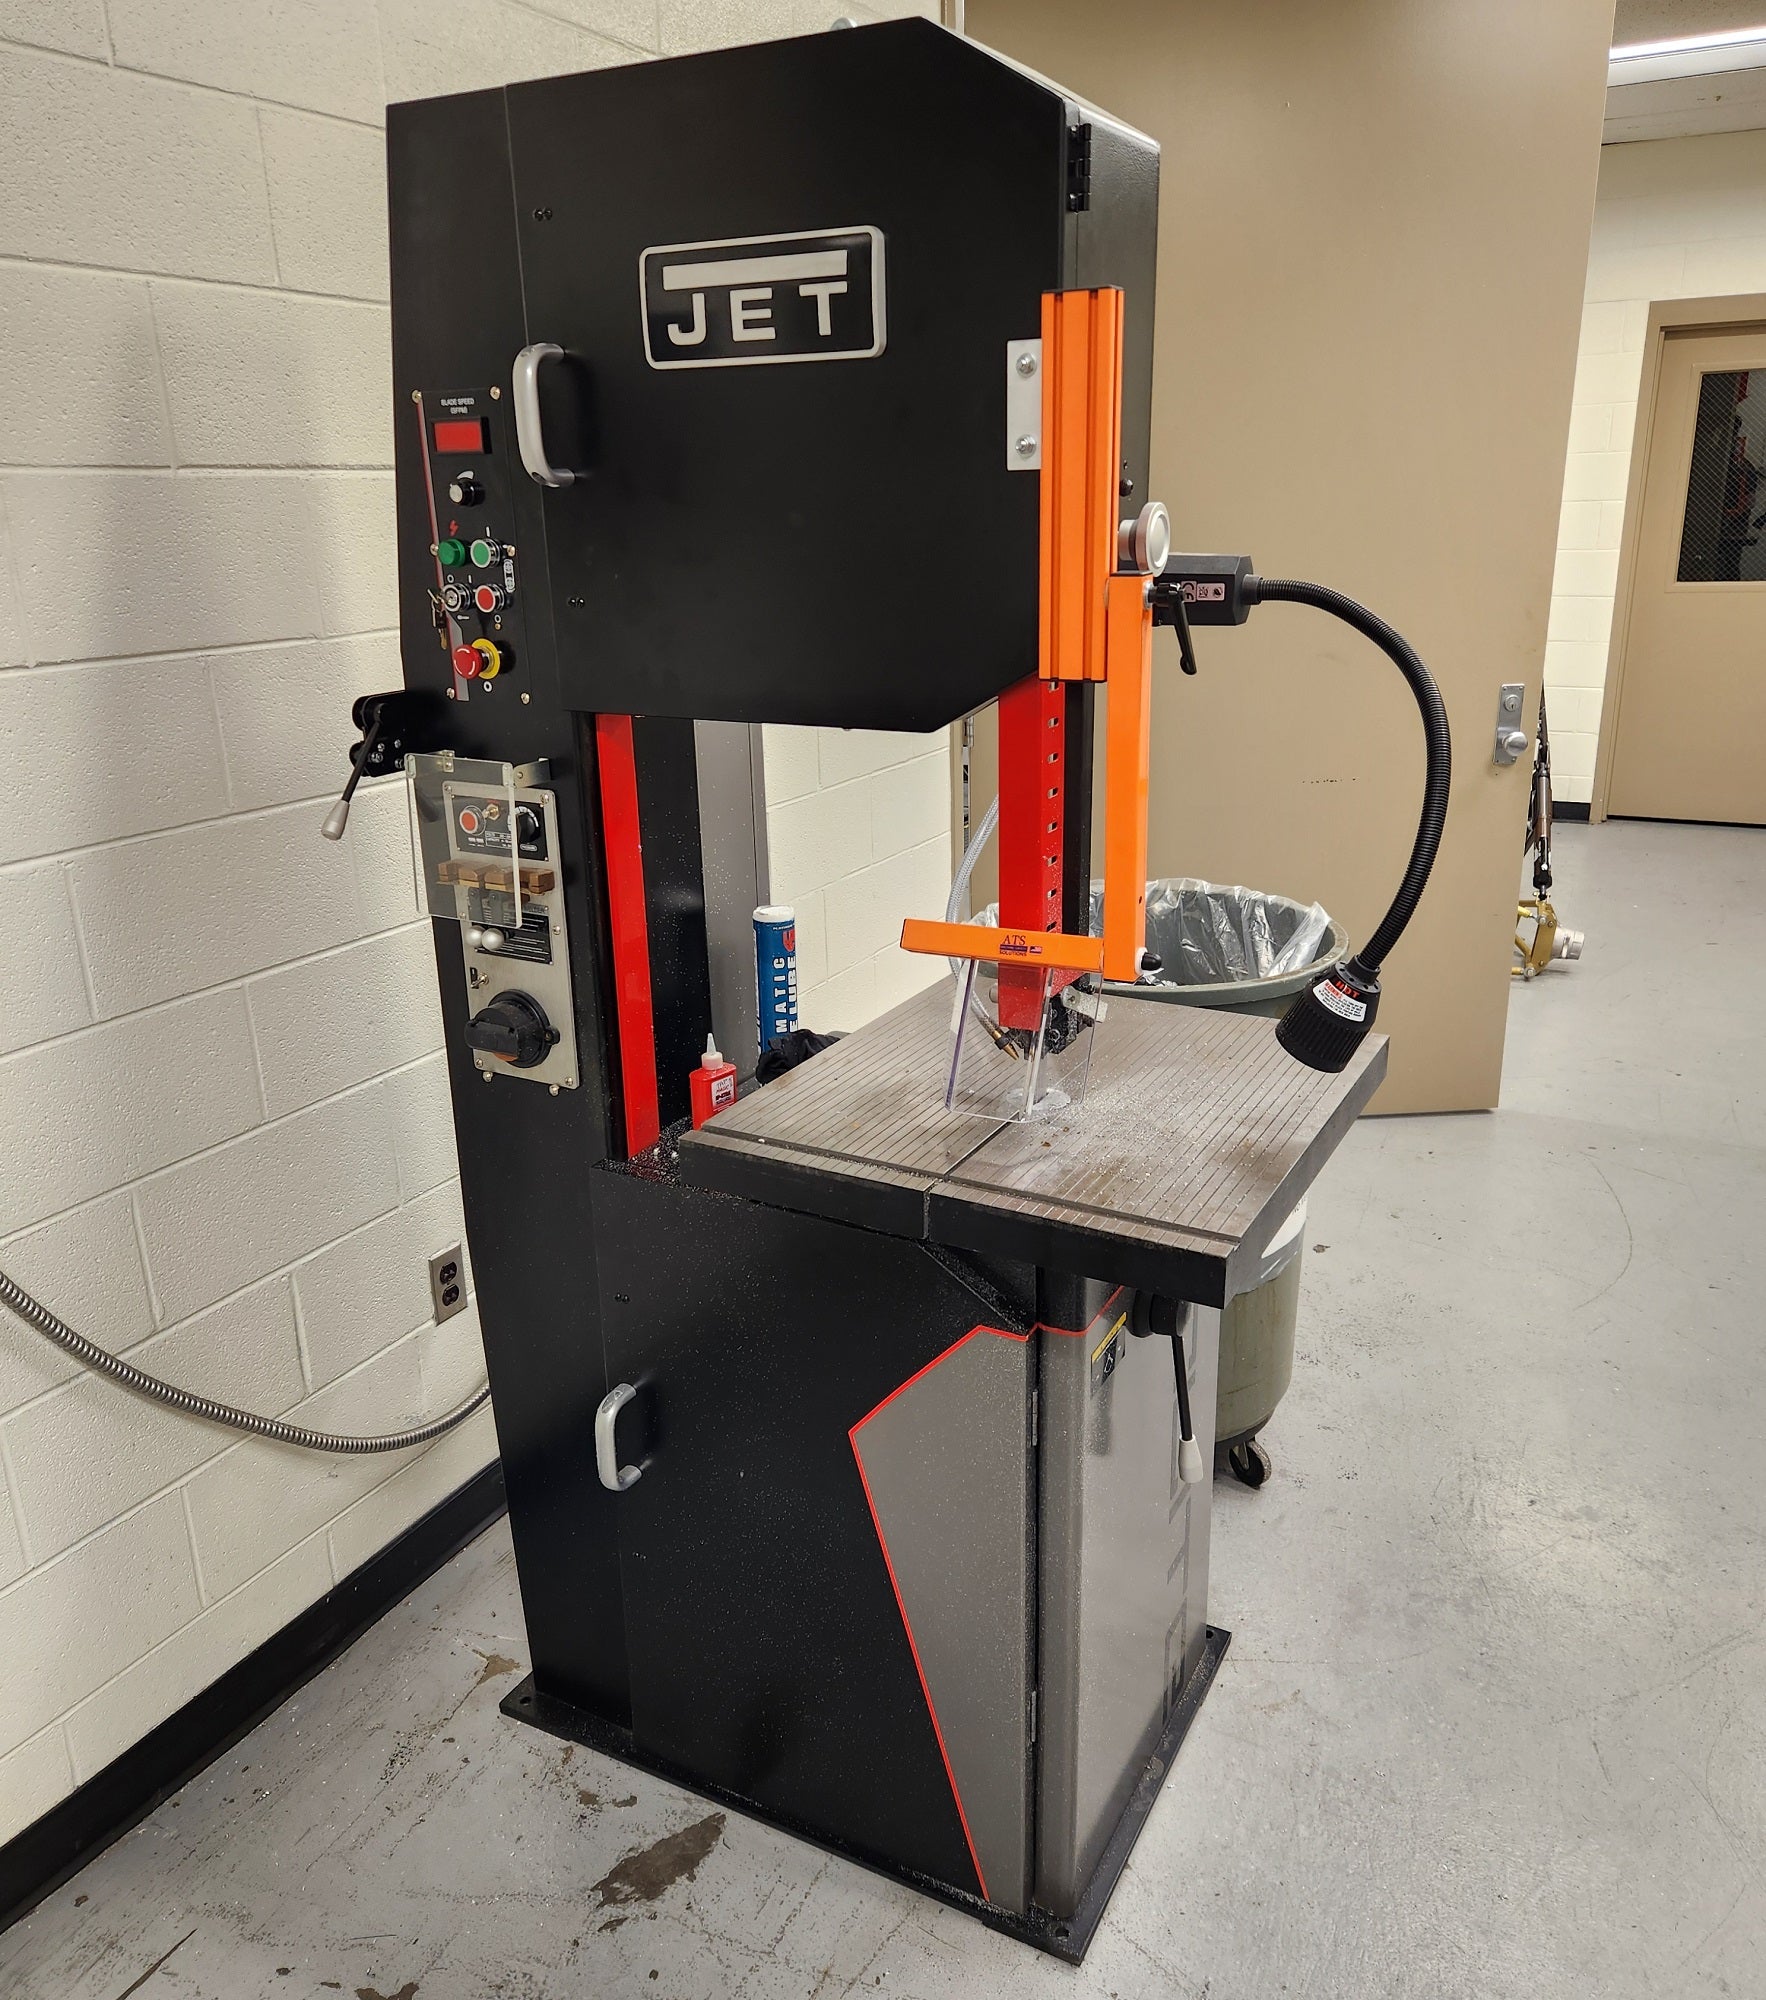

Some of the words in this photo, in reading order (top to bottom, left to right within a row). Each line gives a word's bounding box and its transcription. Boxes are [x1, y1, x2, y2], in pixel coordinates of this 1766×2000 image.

[663, 280, 848, 346] JET
[457, 397, 475, 406] SPEED
[1003, 934, 1026, 946] ATS
[773, 957, 788, 1033] MATIC
[1335, 981, 1360, 998] HOT
